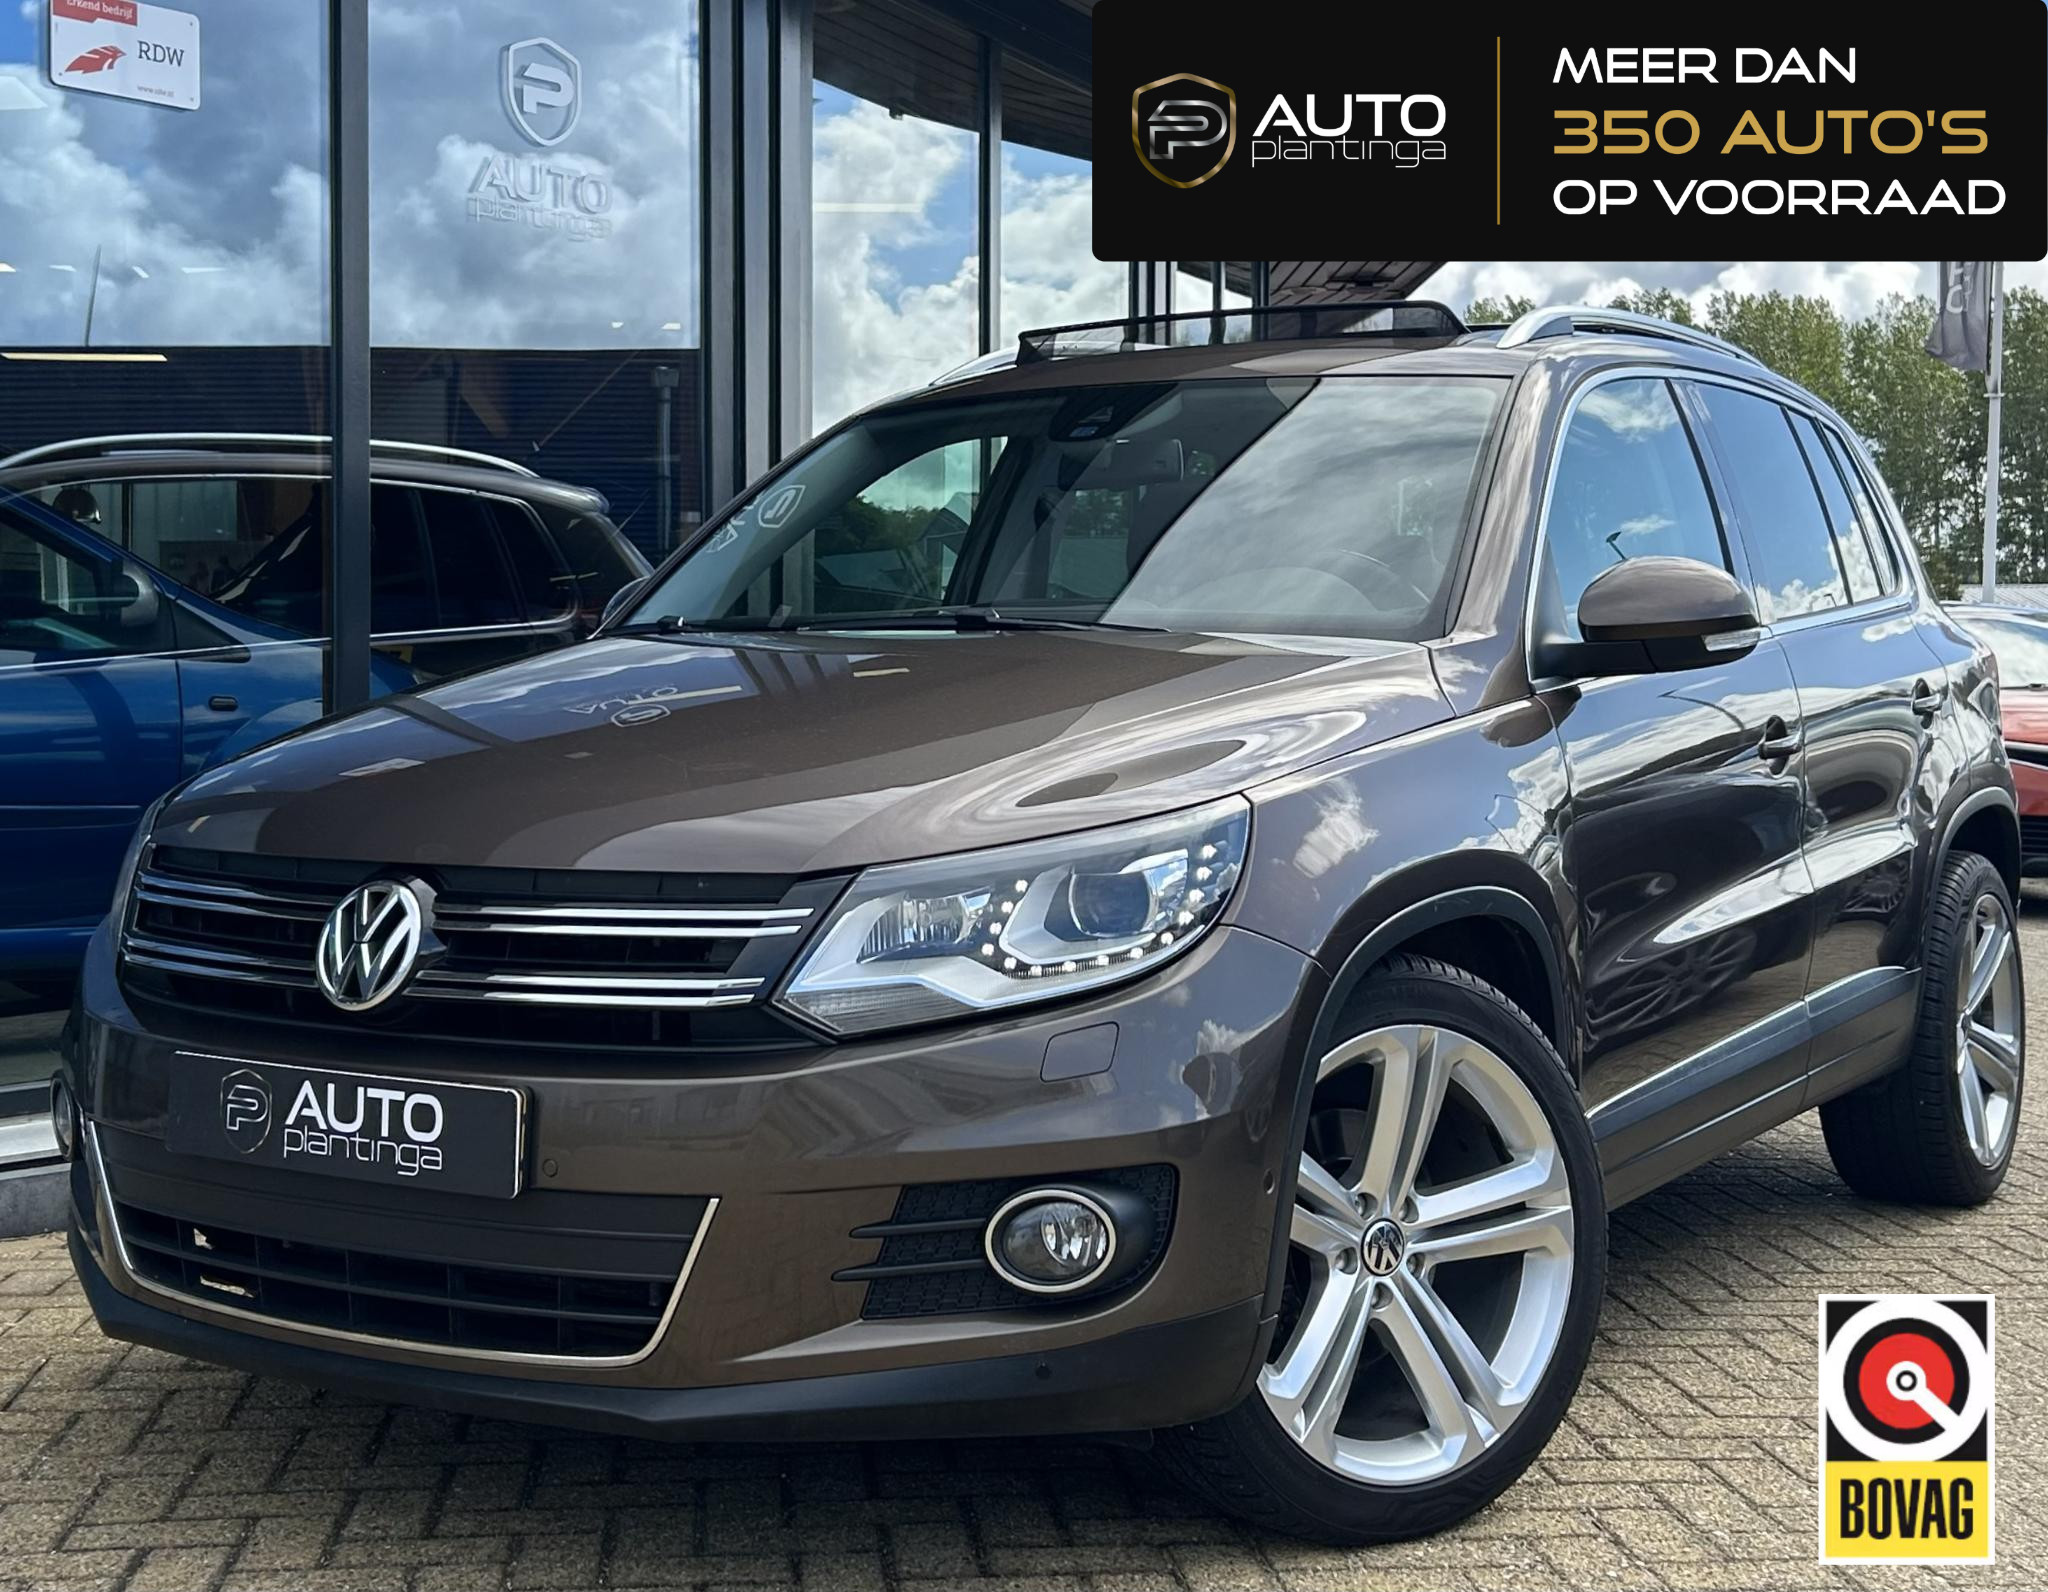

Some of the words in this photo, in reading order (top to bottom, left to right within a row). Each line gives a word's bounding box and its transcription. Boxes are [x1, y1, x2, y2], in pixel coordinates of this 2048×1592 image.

[137, 40, 185, 67] RDW
[473, 153, 612, 215] AUTO
[284, 1079, 444, 1143] AUTO
[283, 1125, 443, 1177] plantinga
